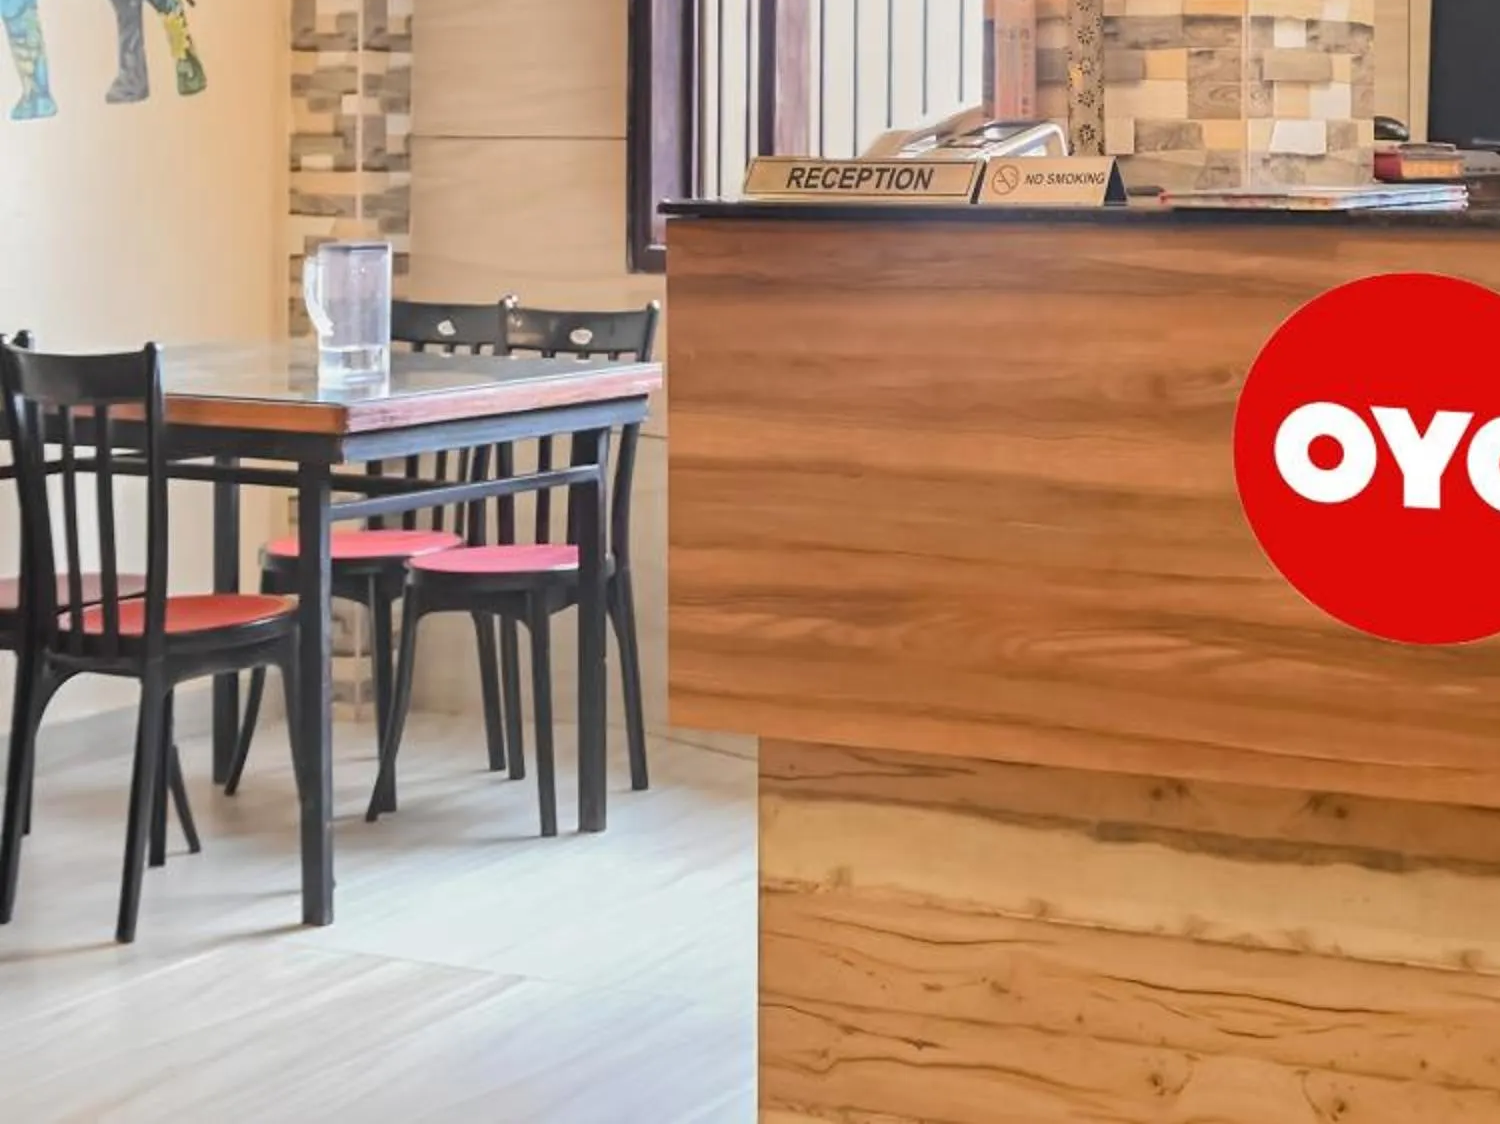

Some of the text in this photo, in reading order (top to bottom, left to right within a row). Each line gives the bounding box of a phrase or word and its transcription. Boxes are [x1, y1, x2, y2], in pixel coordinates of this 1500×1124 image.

[786, 167, 934, 189] RECEPTION
[1025, 172, 1105, 185] NO SMOKING
